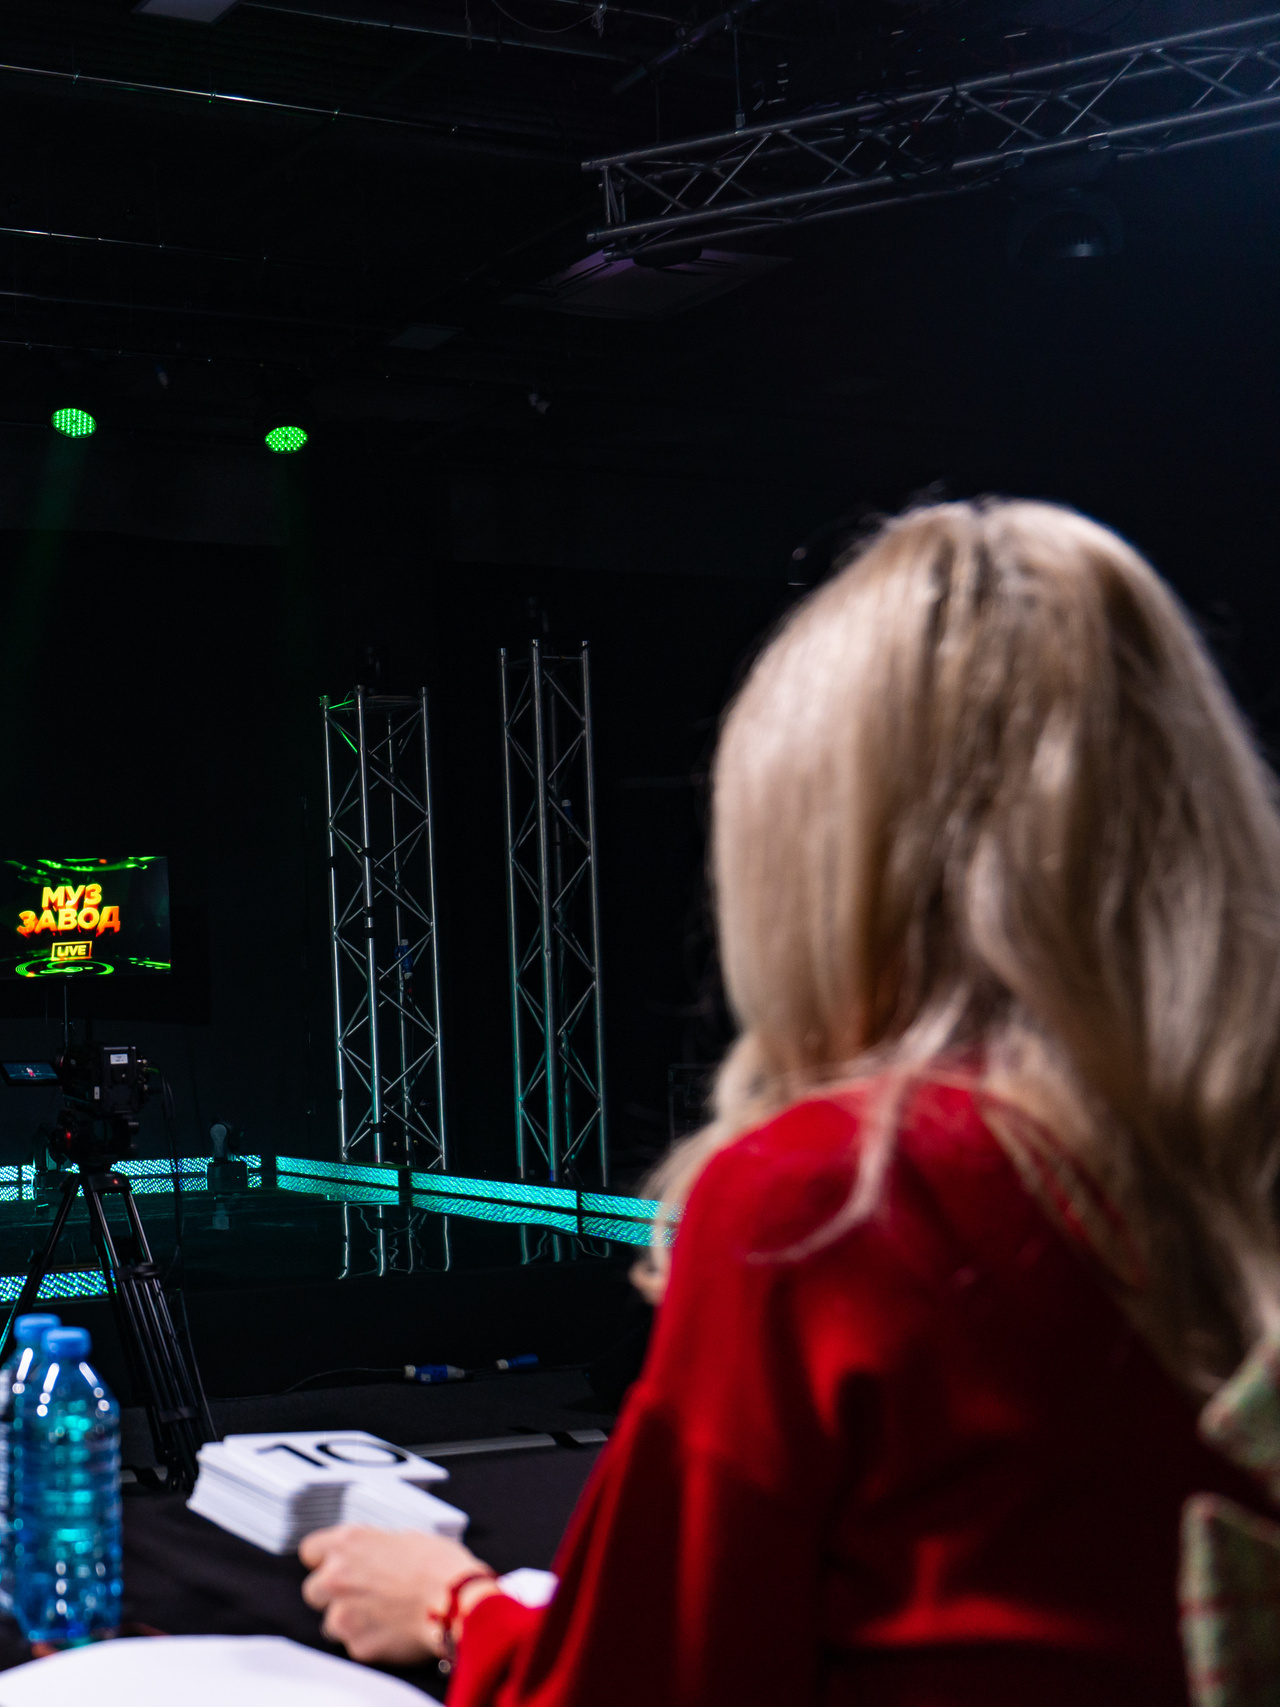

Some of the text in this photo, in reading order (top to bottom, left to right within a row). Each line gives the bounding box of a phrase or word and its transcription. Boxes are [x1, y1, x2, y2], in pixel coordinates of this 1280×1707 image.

[42, 884, 102, 909] МУЗ
[17, 906, 120, 937] ЗАВОД
[57, 945, 86, 957] LIVE
[256, 1439, 408, 1469] 10
